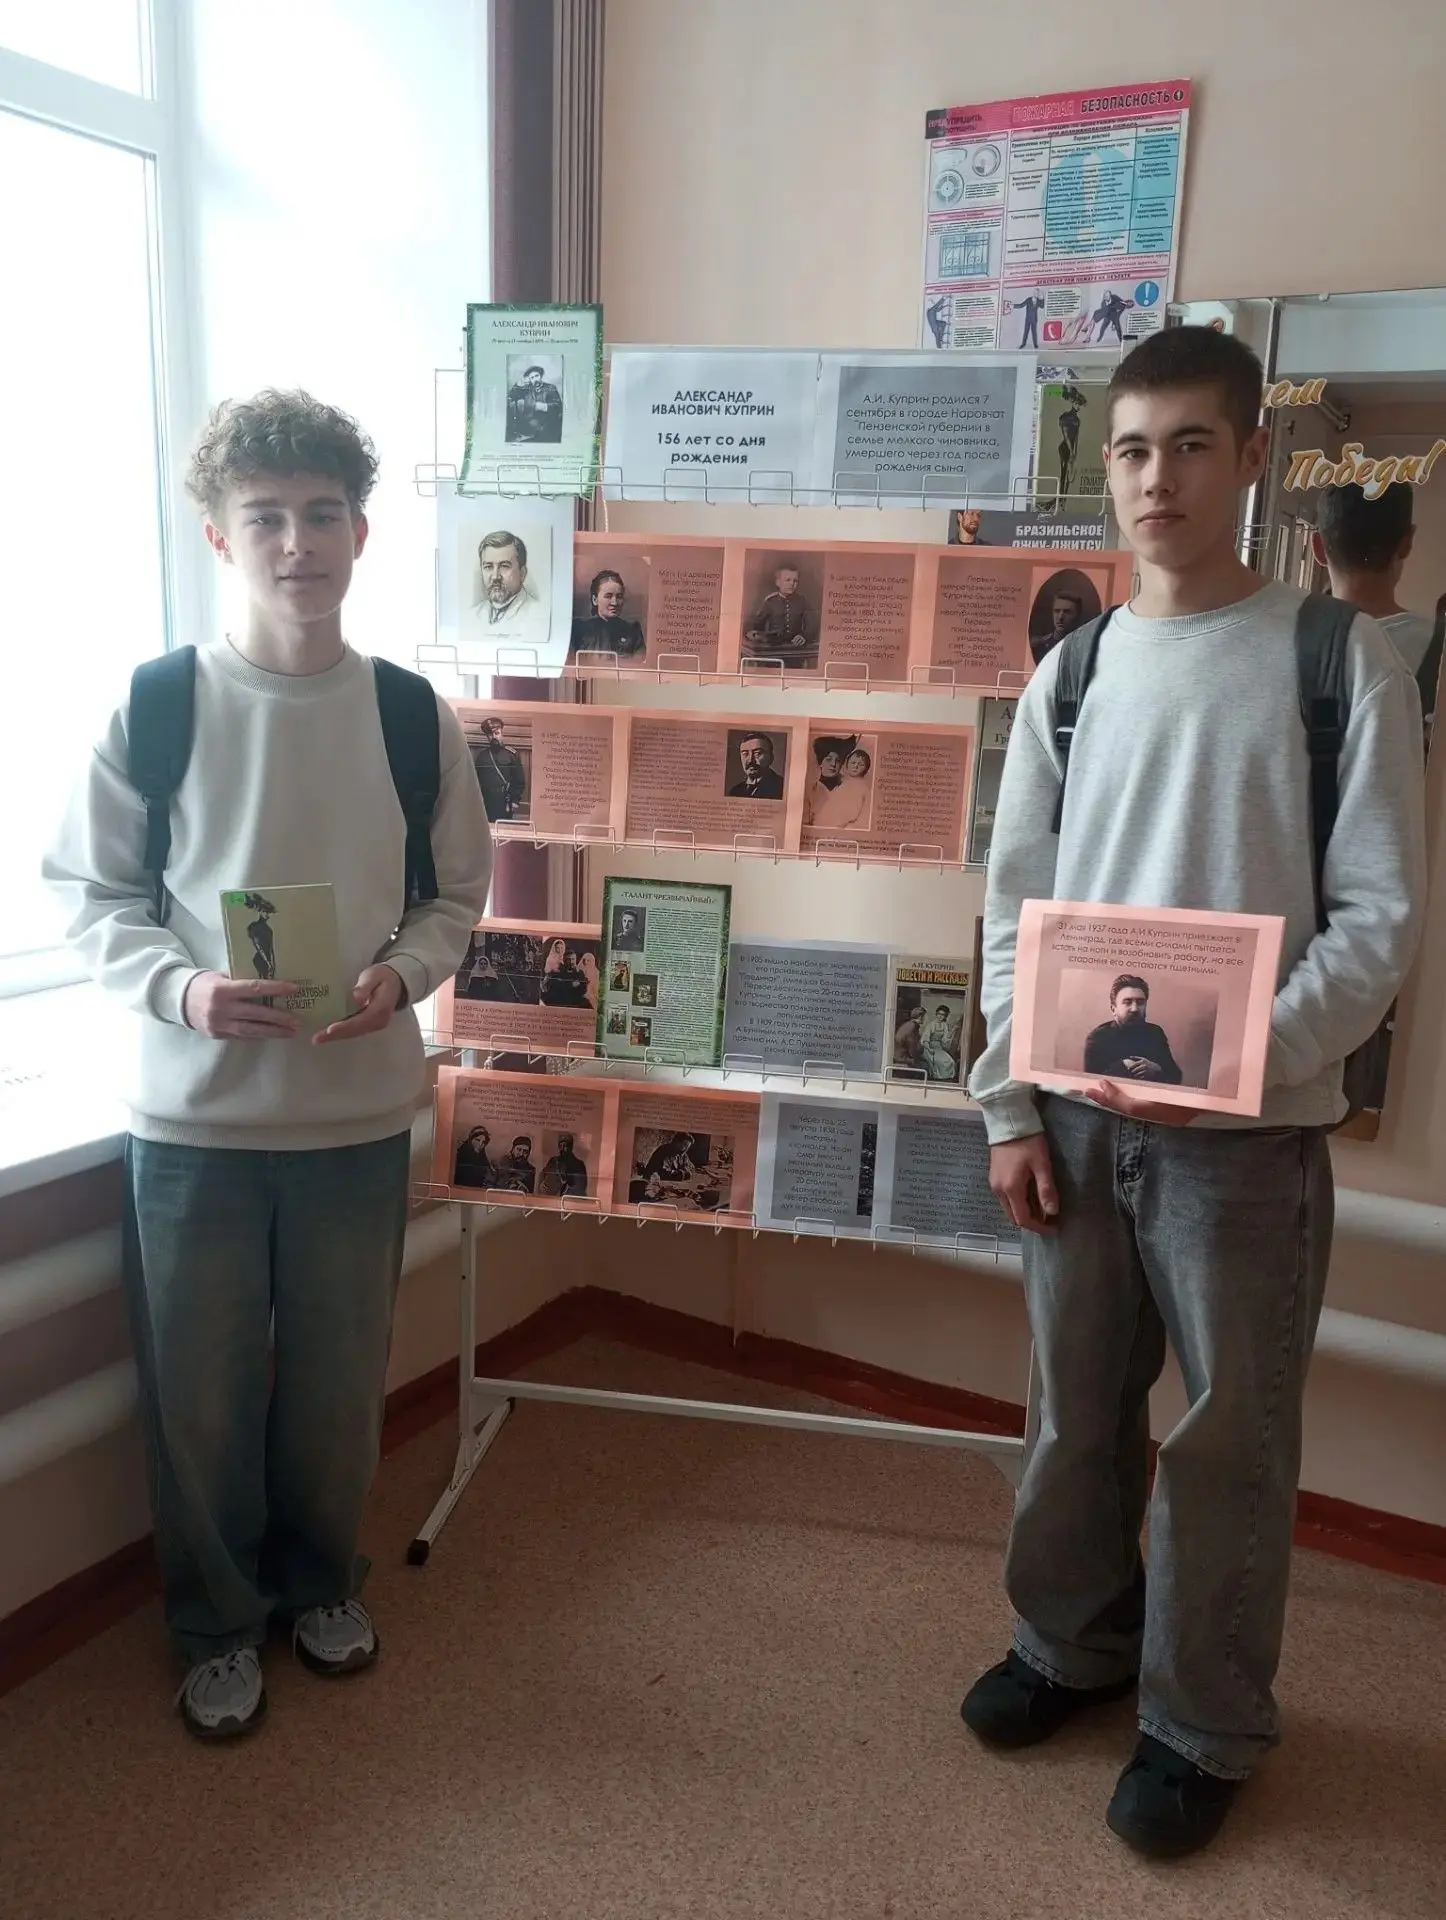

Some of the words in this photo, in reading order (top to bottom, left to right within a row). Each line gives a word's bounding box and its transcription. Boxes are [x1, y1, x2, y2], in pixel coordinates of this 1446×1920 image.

[1012, 101, 1074, 123] ПОЖАРНАЯ
[1080, 91, 1171, 113] БЕЗОПАСНОСТЬ
[674, 391, 753, 403] АЛЕКСАНДР
[863, 394, 885, 404] А.И.
[888, 394, 929, 405] Куприн
[932, 395, 980, 405] родился
[983, 395, 990, 404] 7
[652, 404, 721, 415] ИВАНОВИЧ
[725, 405, 774, 415] КУПРИН
[846, 408, 896, 420] сентября
[899, 410, 905, 418] в
[908, 409, 948, 419] городе
[951, 408, 1005, 420] Наровчат
[928, 422, 982, 433] губернии
[985, 424, 991, 432] в
[657, 433, 680, 444] 156
[685, 436, 711, 445] лет
[715, 436, 734, 445] со
[739, 436, 766, 447] дня
[847, 435, 884, 444] семье
[887, 436, 935, 446] мелкого
[938, 437, 1000, 447] чиновника,
[671, 453, 748, 464] рождения
[845, 449, 905, 460] умершего
[907, 451, 940, 460] через
[943, 451, 961, 460] год
[964, 452, 1000, 460] после
[875, 462, 932, 473] рождения
[1015, 524, 1104, 537] БРАЗИЛЬСКОЕ
[1088, 923, 1107, 932] 1937
[1108, 927, 1129, 935] года
[1148, 929, 1180, 938] Куприн
[1182, 932, 1233, 943] приезжает
[1125, 939, 1153, 947] всеми
[1156, 941, 1192, 950] силами
[1194, 944, 1236, 953] пытается
[1119, 949, 1171, 959] возобновить
[1068, 955, 1107, 965] старания
[1109, 959, 1124, 967] его
[1126, 961, 1167, 970] остаются
